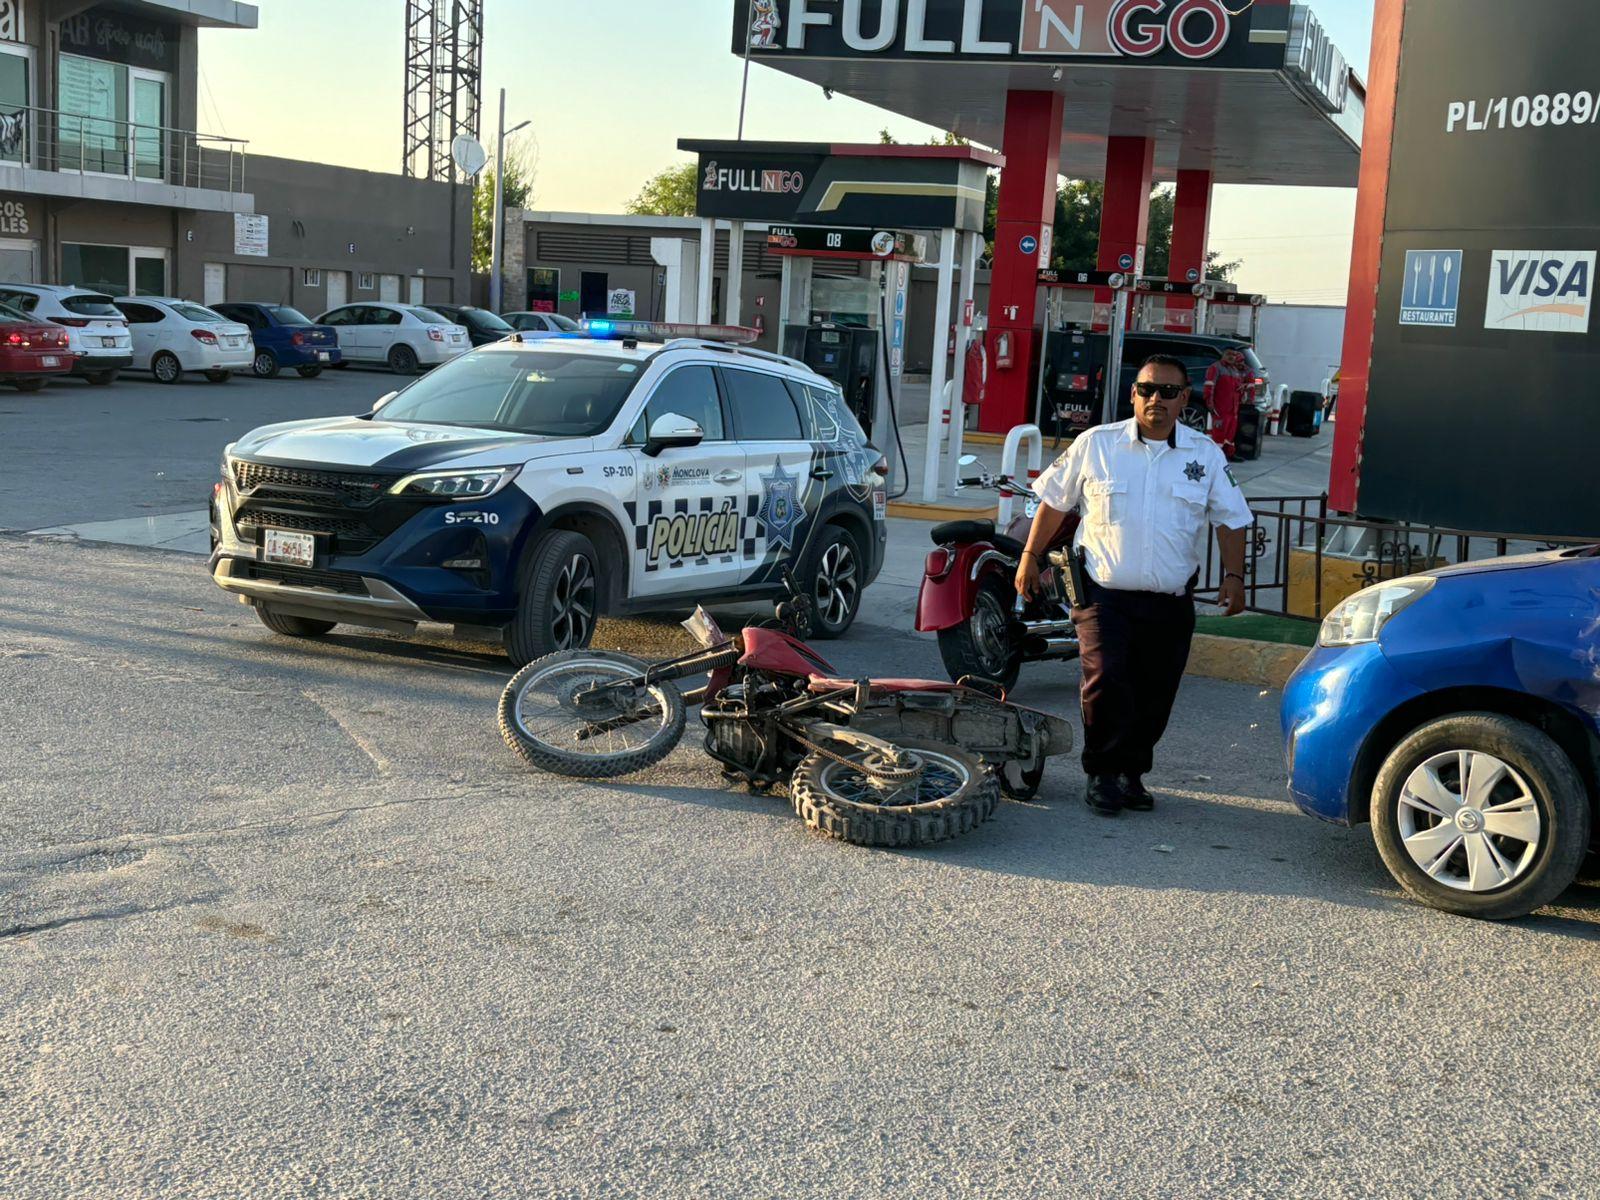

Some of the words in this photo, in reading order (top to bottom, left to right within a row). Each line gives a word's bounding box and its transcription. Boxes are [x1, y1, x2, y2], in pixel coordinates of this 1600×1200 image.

[786, 0, 1012, 54] FULL
[1110, 0, 1231, 60] GO
[717, 168, 761, 192] FULL
[781, 170, 804, 194] GO
[771, 227, 795, 237] FULL
[826, 232, 842, 248] 08
[1496, 258, 1589, 298] VISA
[1401, 309, 1455, 324] RESTAURANTE
[1064, 403, 1091, 412] FULL
[603, 465, 634, 478] SP-210
[672, 466, 710, 478] MONCLOVA
[650, 498, 739, 560] POLICÍA
